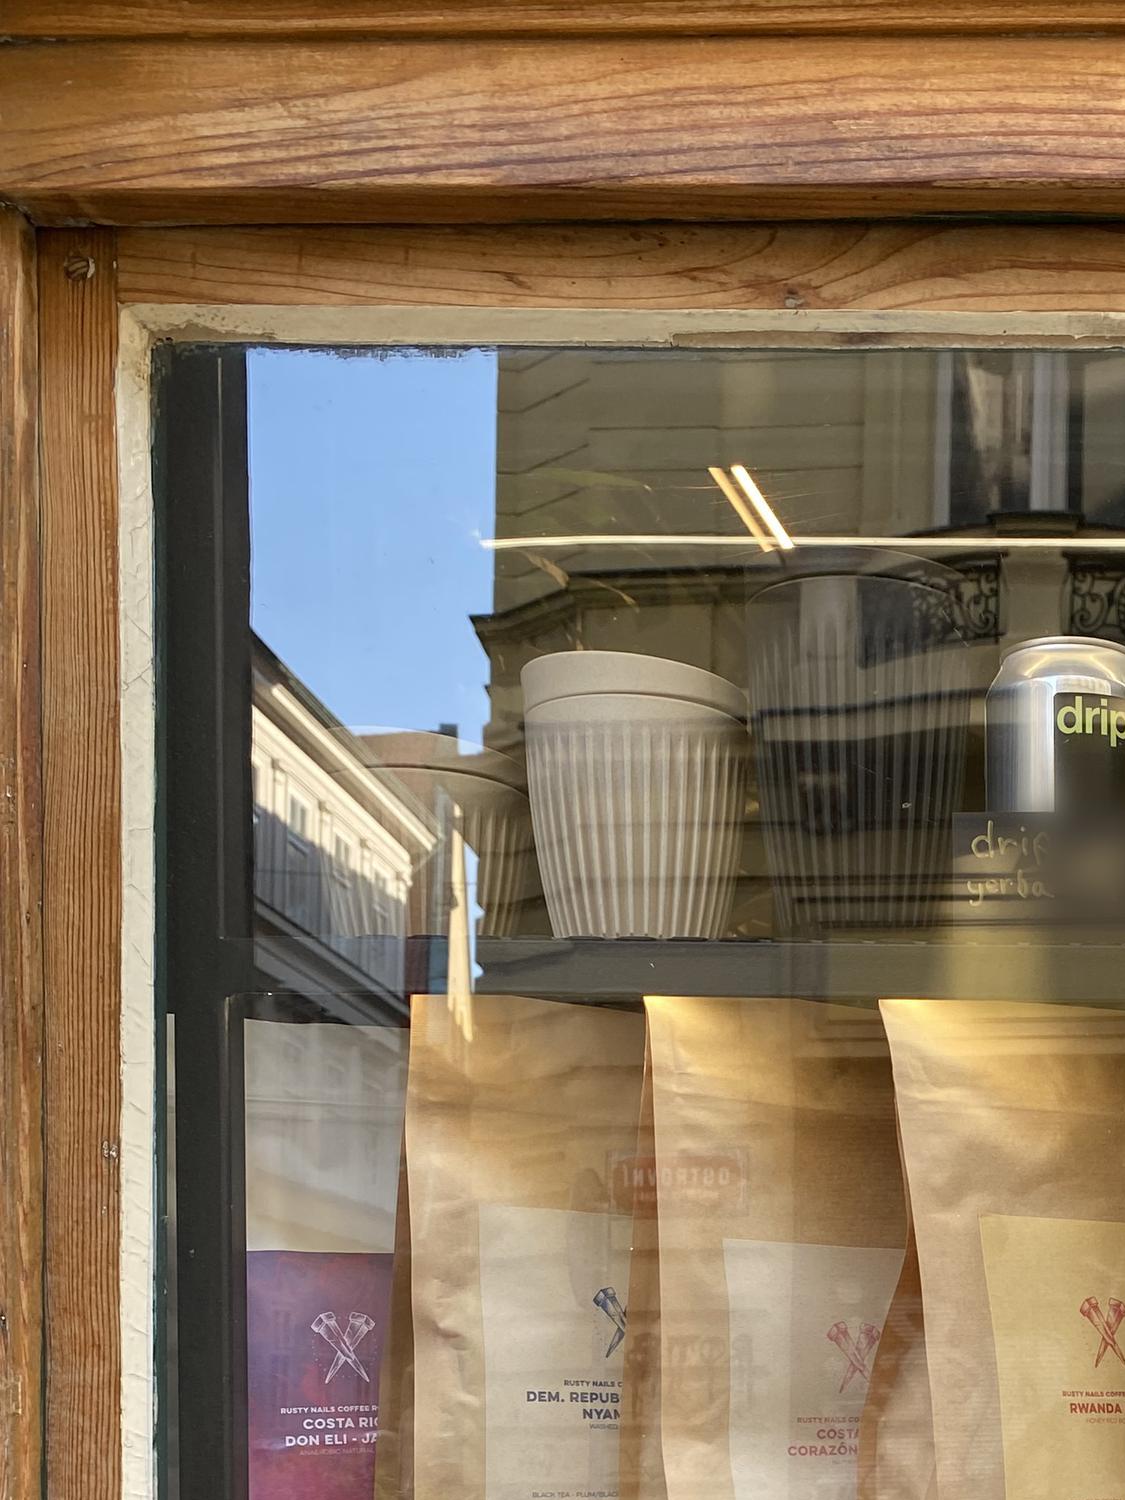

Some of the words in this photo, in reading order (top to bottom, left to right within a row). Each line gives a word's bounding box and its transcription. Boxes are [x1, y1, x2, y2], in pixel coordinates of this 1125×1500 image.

[526, 1391, 565, 1403] DEM.
[1069, 1403, 1122, 1414] RWANDA
[303, 1417, 355, 1430] COSTA
[285, 1434, 319, 1447] DON
[324, 1434, 348, 1445] ELI
